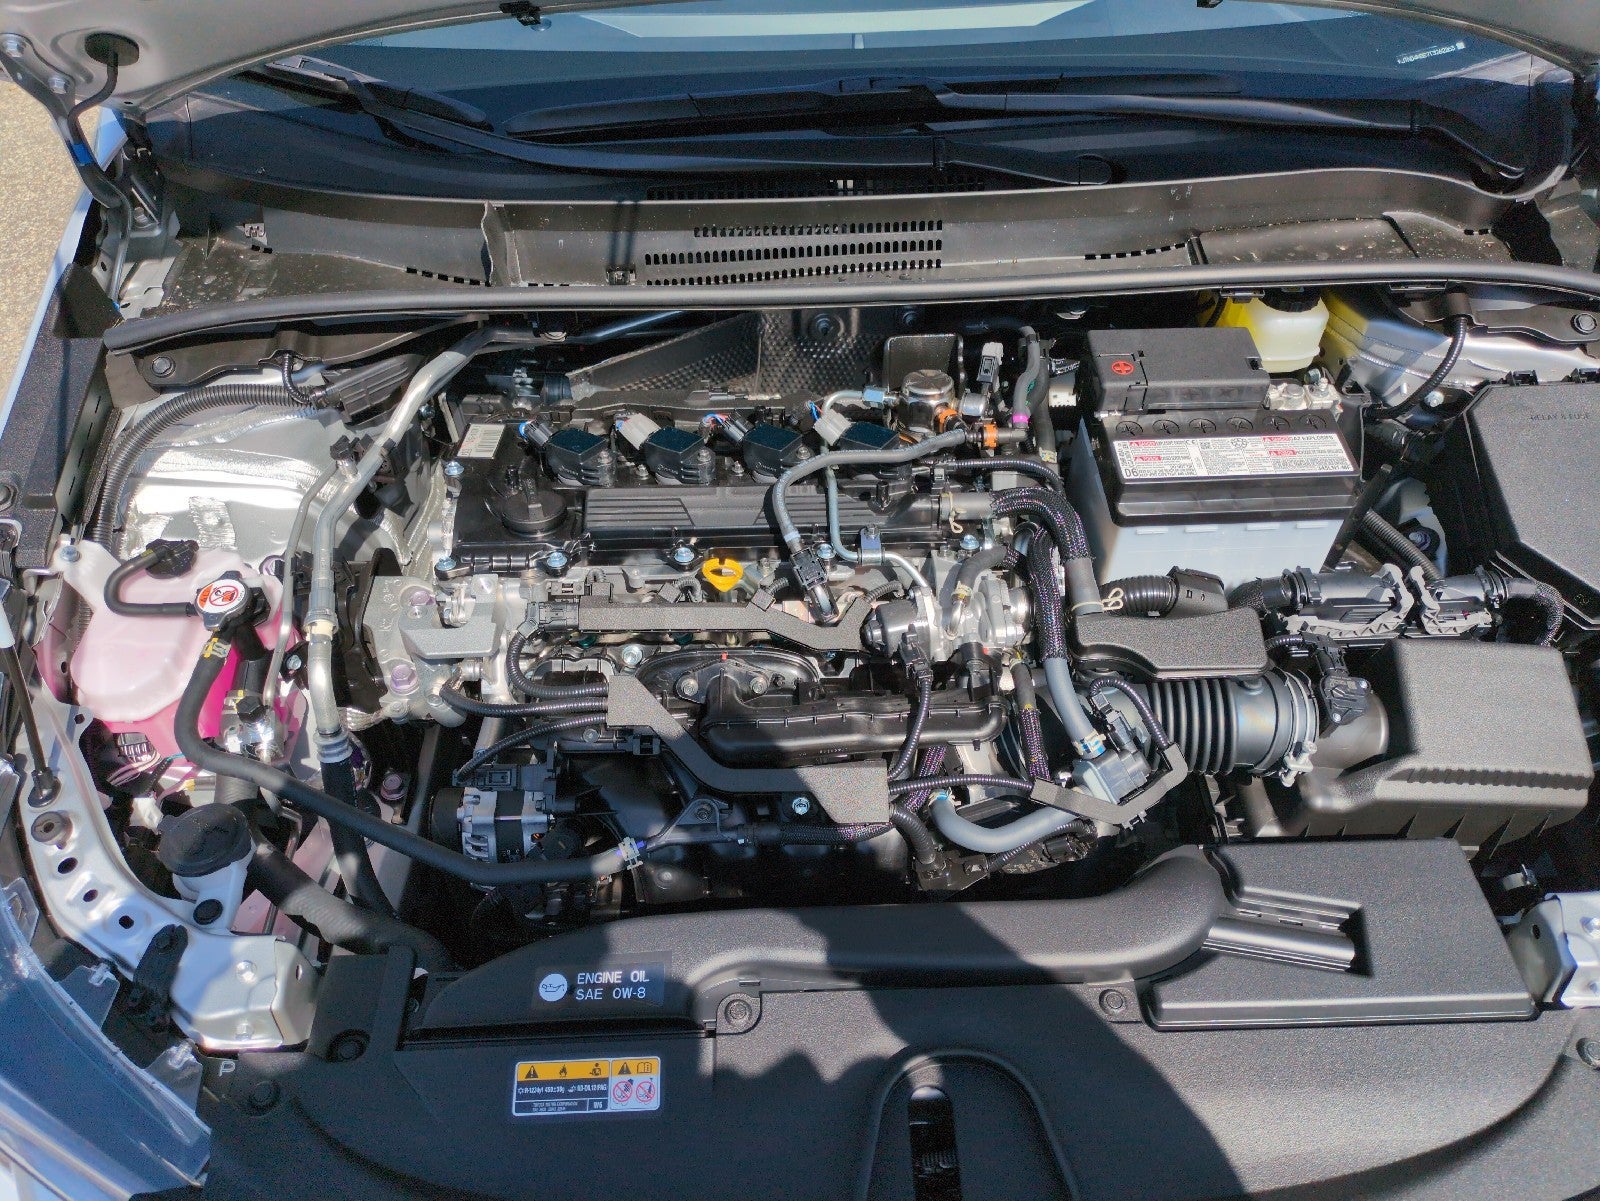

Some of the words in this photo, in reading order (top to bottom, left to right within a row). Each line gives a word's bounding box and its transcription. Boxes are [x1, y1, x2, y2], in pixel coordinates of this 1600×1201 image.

[577, 971, 622, 984] ENGINE
[630, 970, 650, 983] OIL
[575, 988, 603, 1000] SAE
[218, 1060, 236, 1077] P
